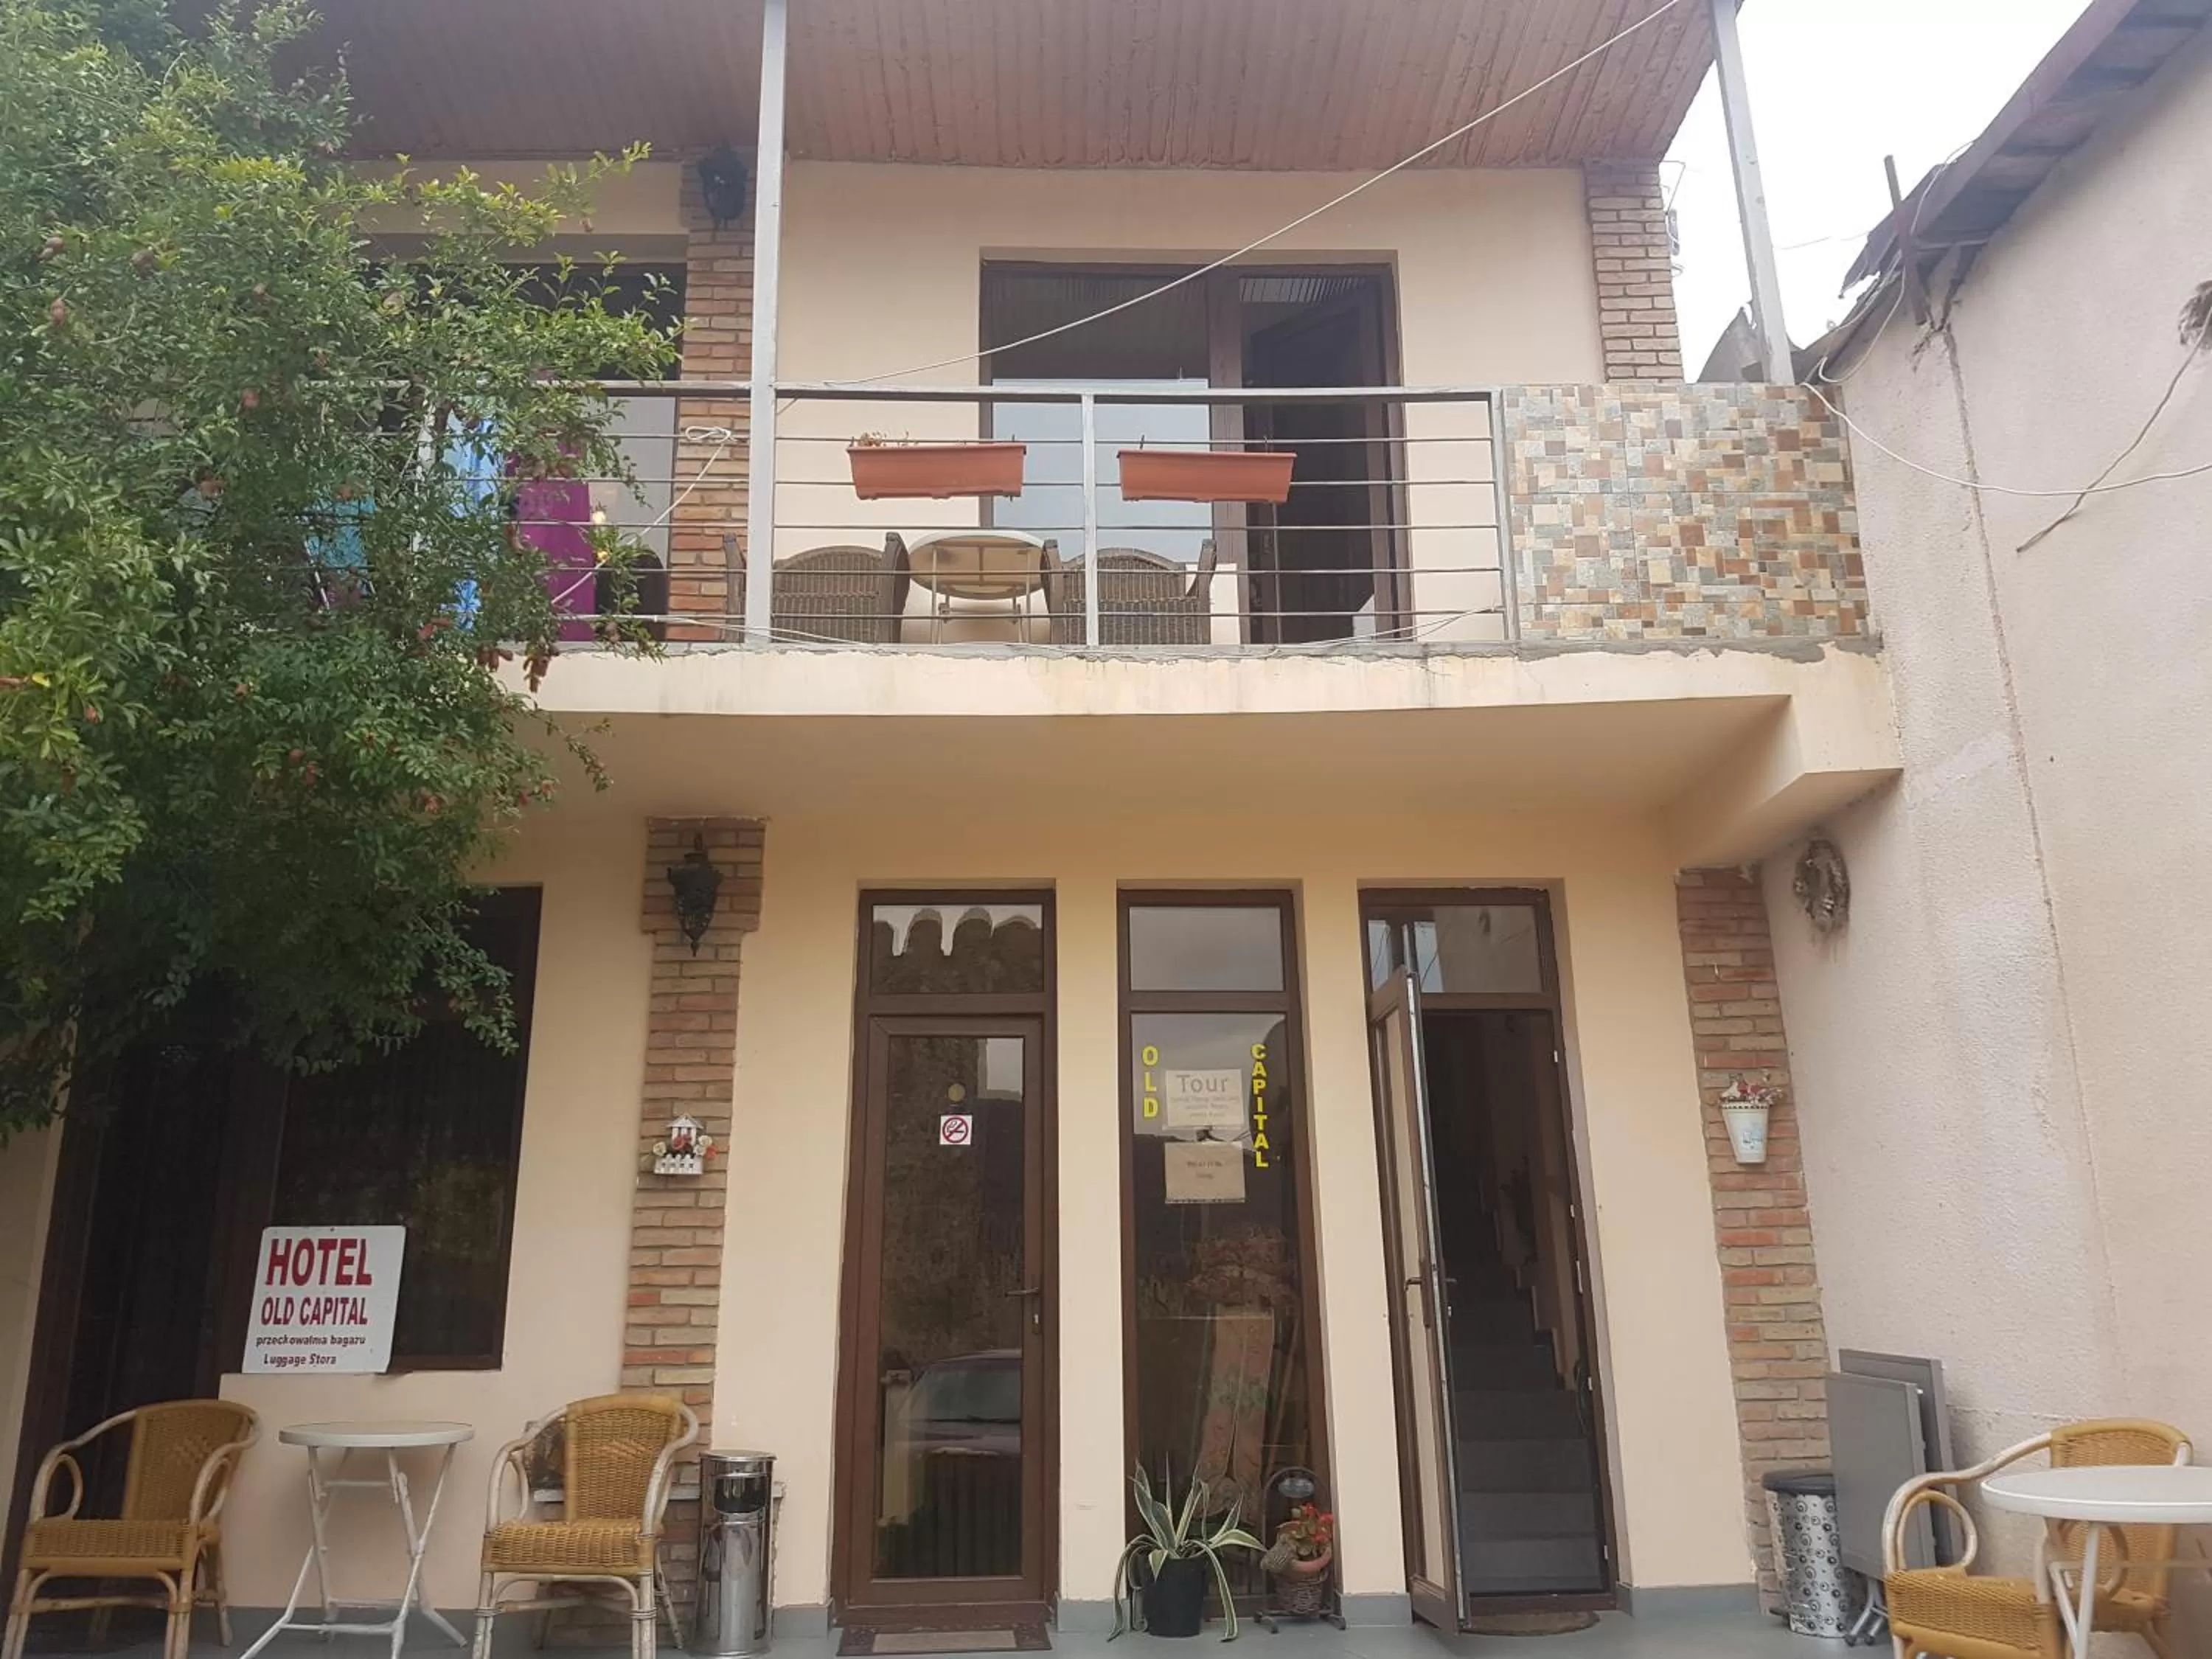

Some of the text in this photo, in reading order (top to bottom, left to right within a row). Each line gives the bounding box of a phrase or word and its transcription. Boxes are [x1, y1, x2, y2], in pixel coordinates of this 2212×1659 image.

[1176, 1074, 1229, 1093] Tour
[1142, 1043, 1270, 1168] OLD CAPITAL
[265, 1238, 372, 1286] HOTEL
[261, 1297, 368, 1326] OLD CAPITAL
[263, 1353, 307, 1368] Luggage
